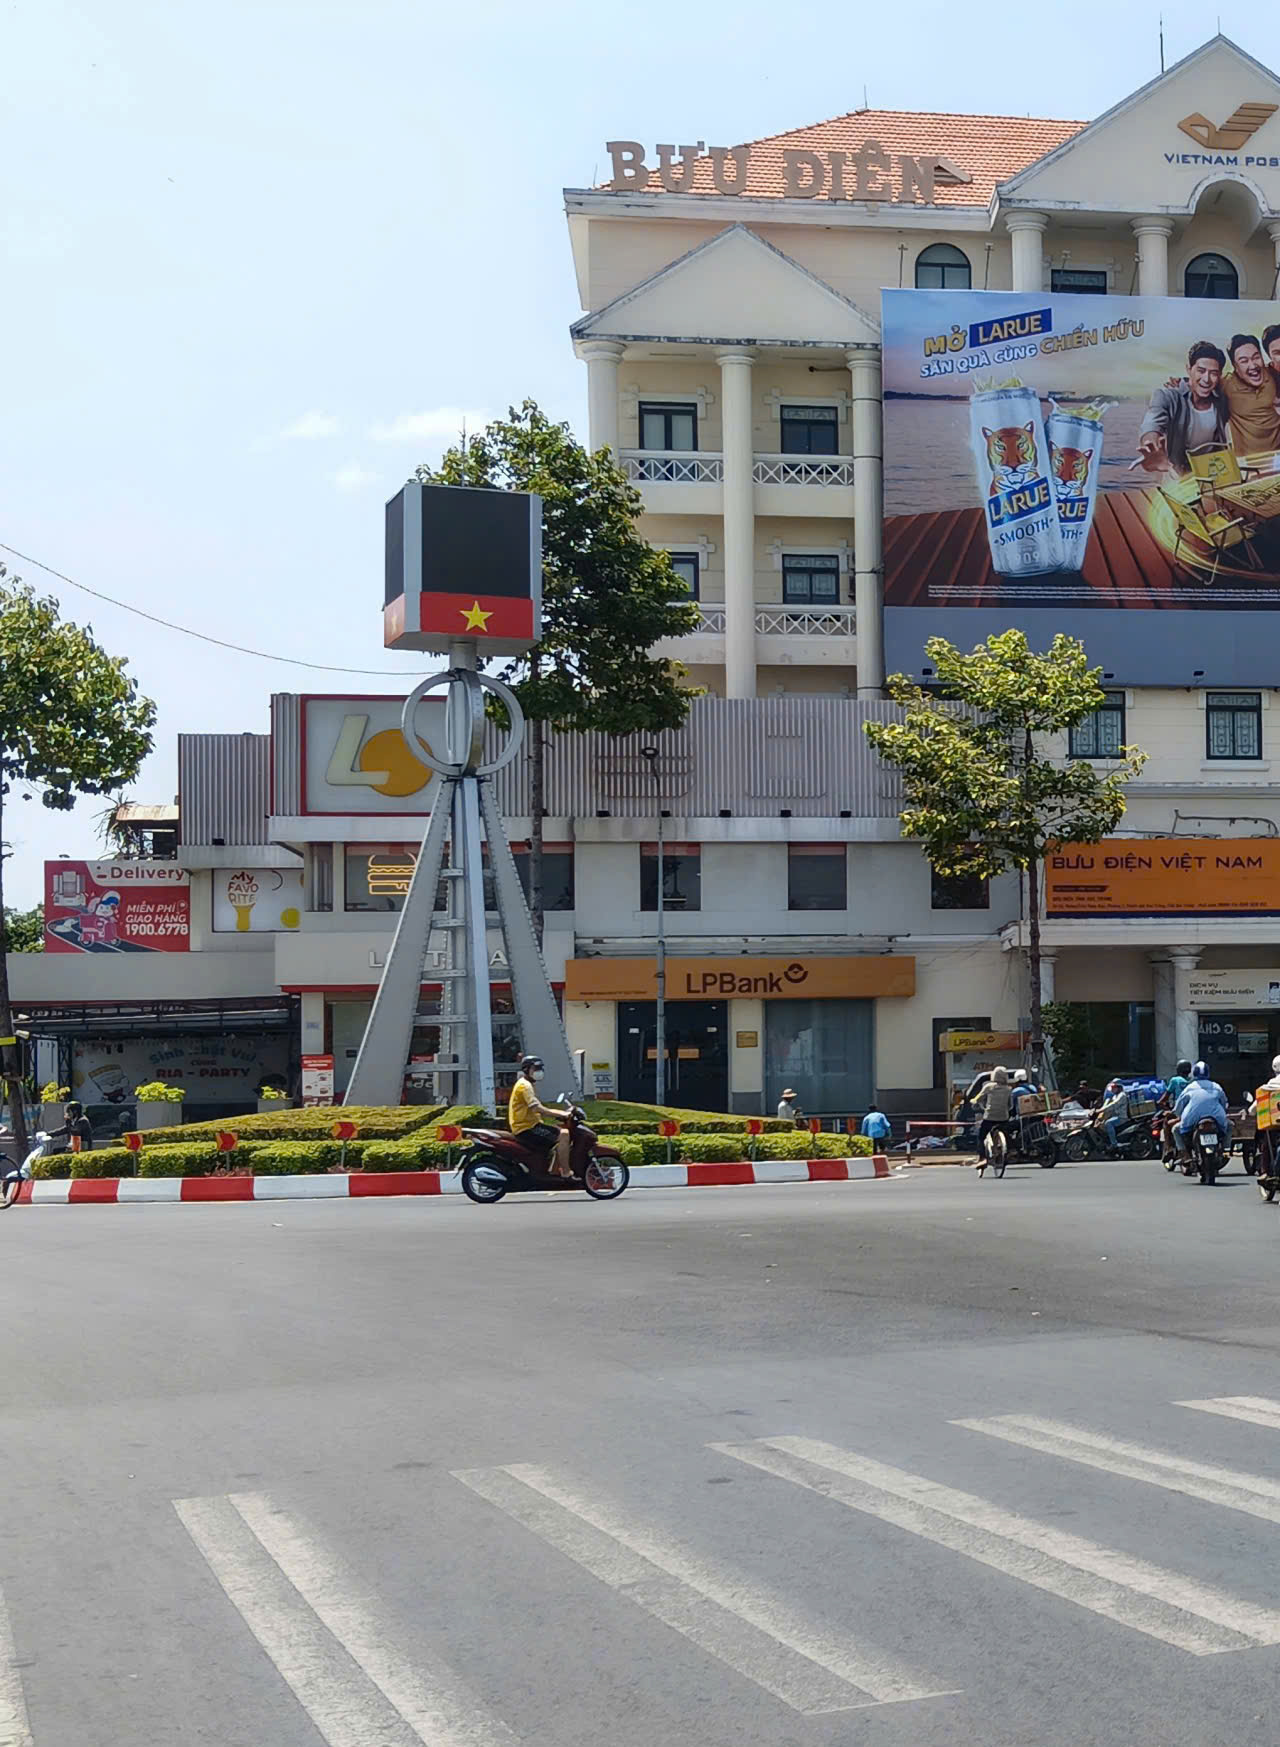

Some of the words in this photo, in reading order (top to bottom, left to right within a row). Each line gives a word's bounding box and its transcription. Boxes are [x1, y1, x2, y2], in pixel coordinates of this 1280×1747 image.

[606, 141, 749, 195] BƯU
[1164, 153, 1238, 166] VIETNAM
[924, 325, 967, 357] MỞ
[978, 314, 1042, 345] LARUE
[956, 350, 991, 374] QUÀ
[993, 342, 1037, 364] CÙNG
[1040, 323, 1097, 354] CHIẾN
[1102, 317, 1145, 343] HỮU
[989, 482, 1050, 521] LARUE
[1057, 501, 1087, 518] RUE
[999, 516, 1049, 546] SMOOTH
[1052, 854, 1094, 869] BƯU
[1104, 852, 1152, 872] ĐIỆN
[1160, 852, 1206, 872] VIỆT
[1215, 856, 1263, 868] NAM
[110, 866, 184, 881] Delivery
[125, 914, 153, 923] GIAO
[154, 912, 187, 923] HÀNG
[125, 924, 188, 936] 1900.6778
[686, 973, 783, 994] LPBank
[200, 1067, 250, 1078] PARTY
